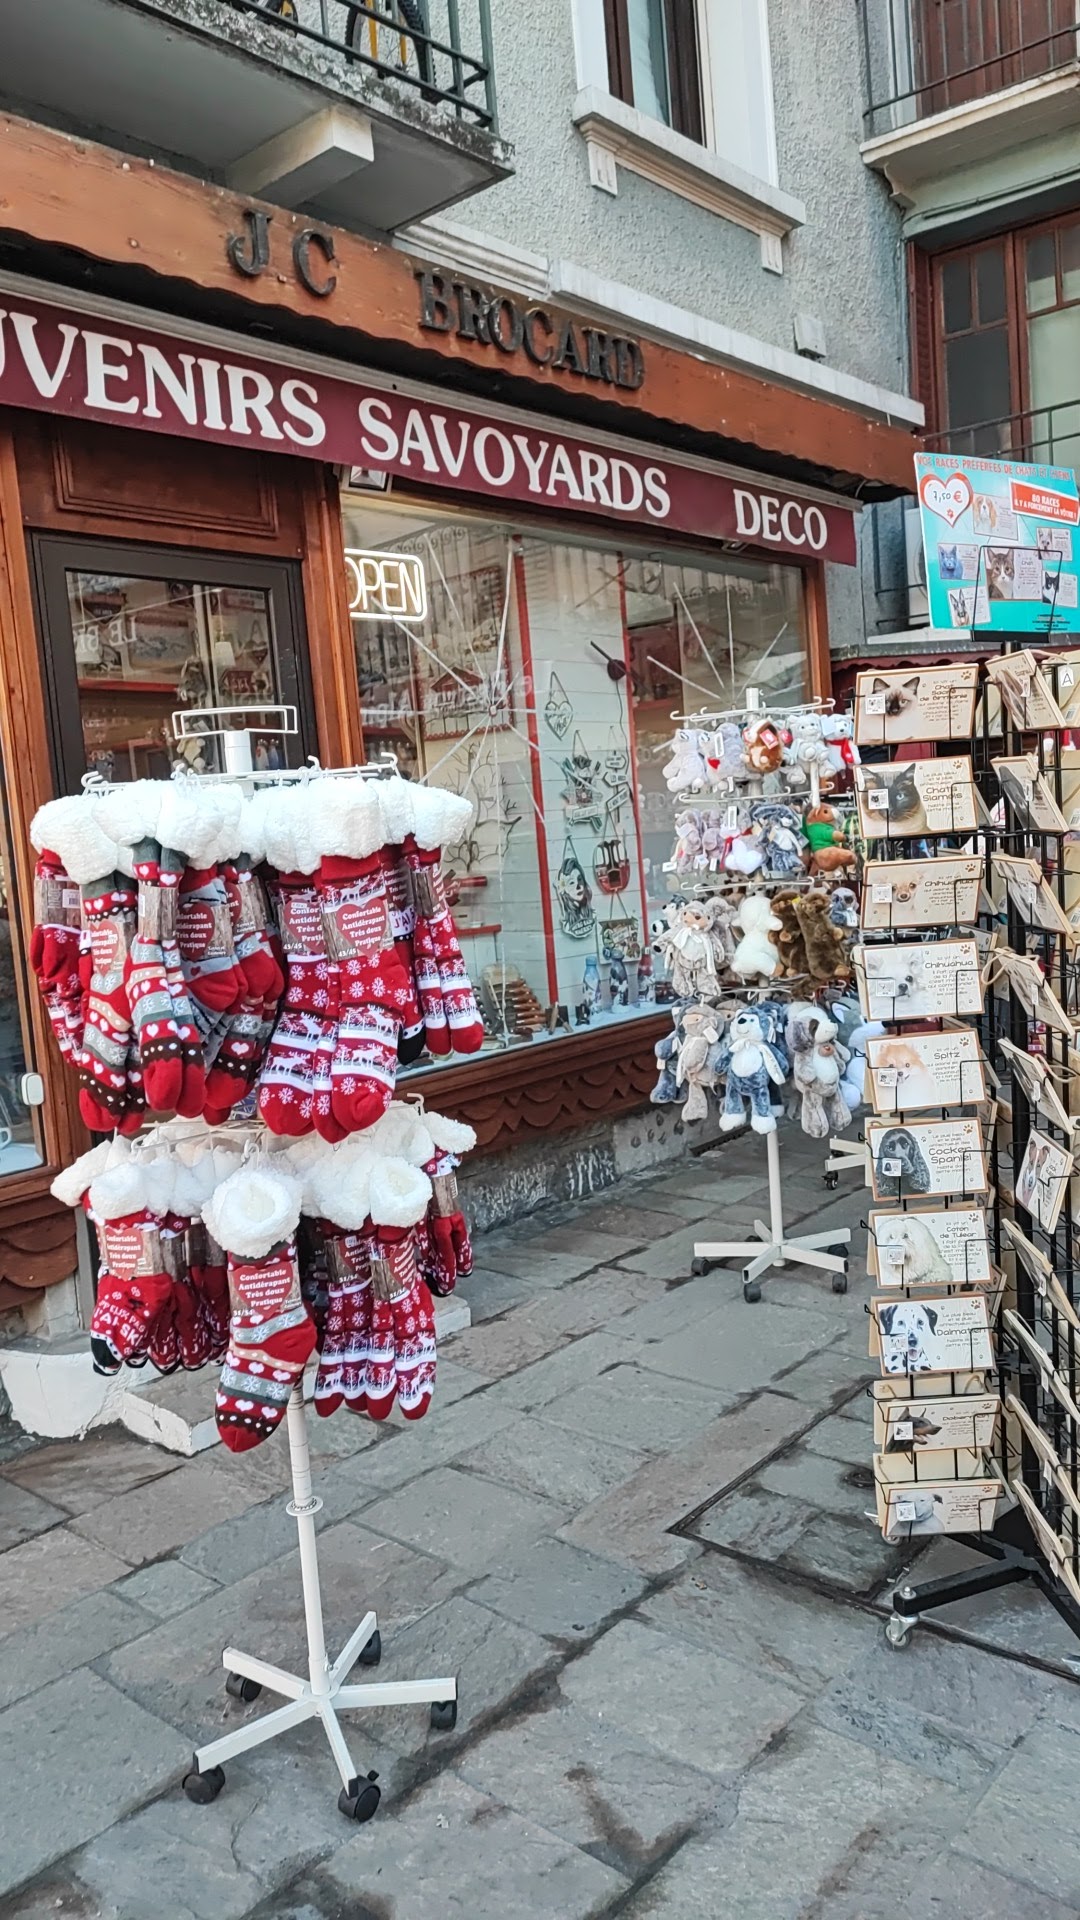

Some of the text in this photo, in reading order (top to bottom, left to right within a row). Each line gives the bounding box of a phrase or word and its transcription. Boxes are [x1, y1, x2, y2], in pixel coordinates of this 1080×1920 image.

[228, 209, 644, 390] J C BROCARD
[0, 309, 828, 550] VENIRS SAVOYARDS DECO
[936, 457, 959, 469] RACES
[1042, 496, 1060, 507] RACES
[345, 556, 421, 613] OPEN
[1062, 673, 1073, 685] A
[291, 907, 320, 915] Confor
[342, 907, 381, 920] Confortable
[289, 916, 320, 925] Antidér
[341, 916, 385, 930] Antidérapant
[296, 925, 315, 933] Très
[349, 926, 382, 938] Très doux
[354, 936, 381, 946] Pratique
[934, 1052, 960, 1060] Spitz
[929, 1147, 971, 1156] Cocker
[931, 1154, 971, 1165] Spaniel
[240, 1269, 286, 1281] Confortable
[238, 1277, 290, 1291] Antidérapant
[246, 1288, 284, 1298] Très doux
[251, 1297, 282, 1307] Pratique
[937, 1327, 986, 1336] Dalmaten
